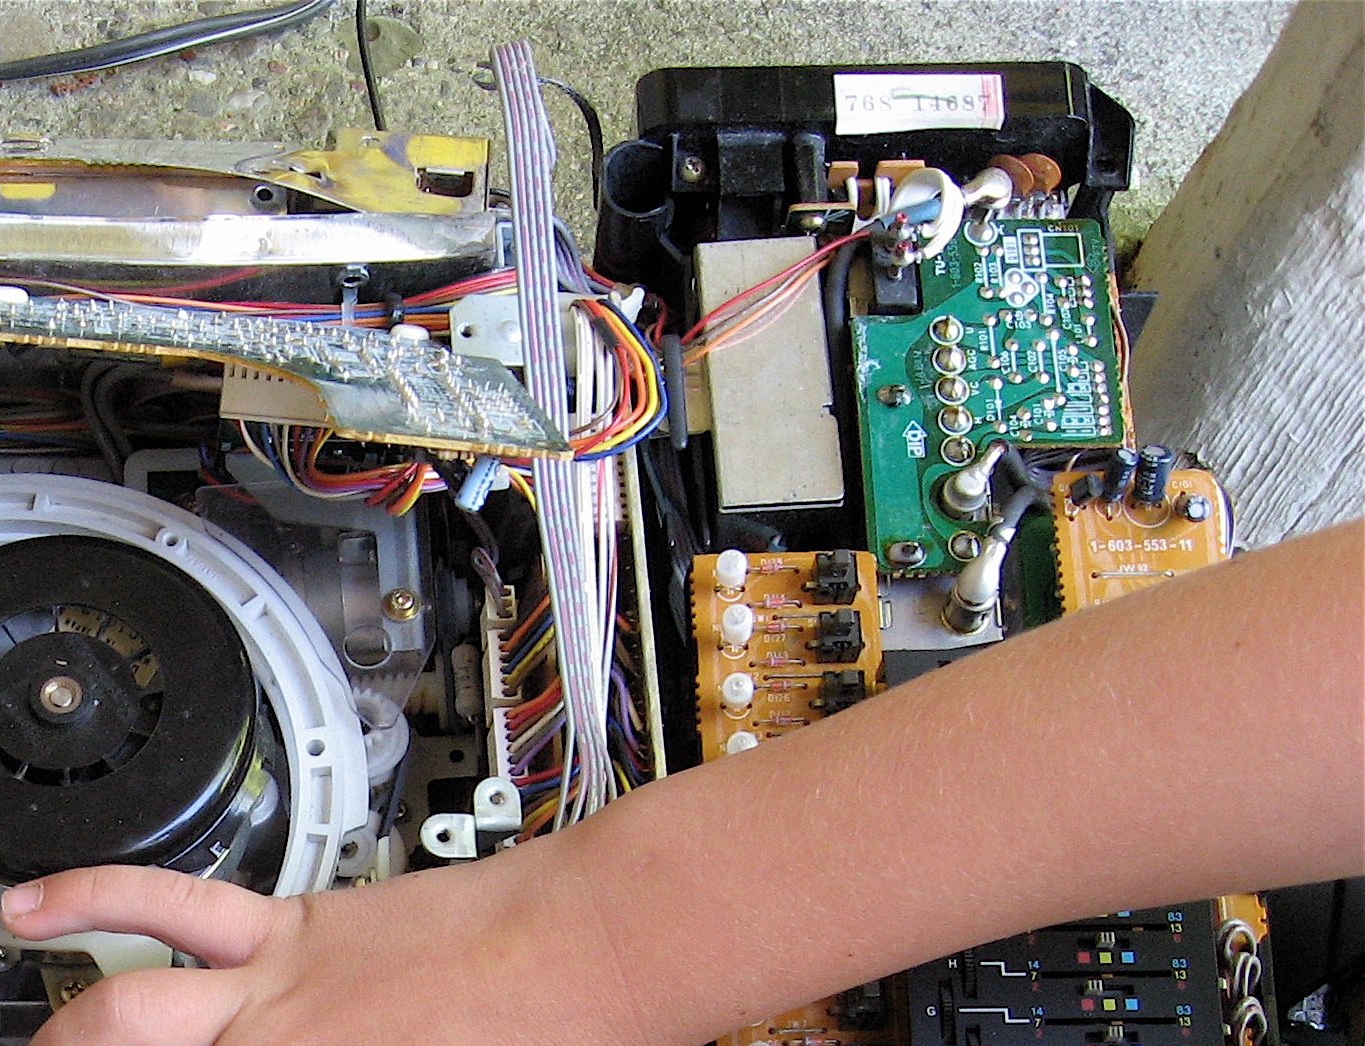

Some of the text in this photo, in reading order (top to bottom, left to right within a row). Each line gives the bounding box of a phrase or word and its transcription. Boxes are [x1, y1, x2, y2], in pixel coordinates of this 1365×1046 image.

[967, 349, 977, 371] AGC
[969, 381, 979, 396] VC
[1090, 538, 1193, 553] 1-603-553-11
[1169, 923, 1183, 933] 13
[947, 958, 958, 969] H
[1027, 959, 1041, 971] 14
[1030, 970, 1187, 981] 7 13
[926, 1006, 937, 1016] G
[1031, 1006, 1044, 1017] 14
[1034, 1016, 1191, 1028] 7 13
